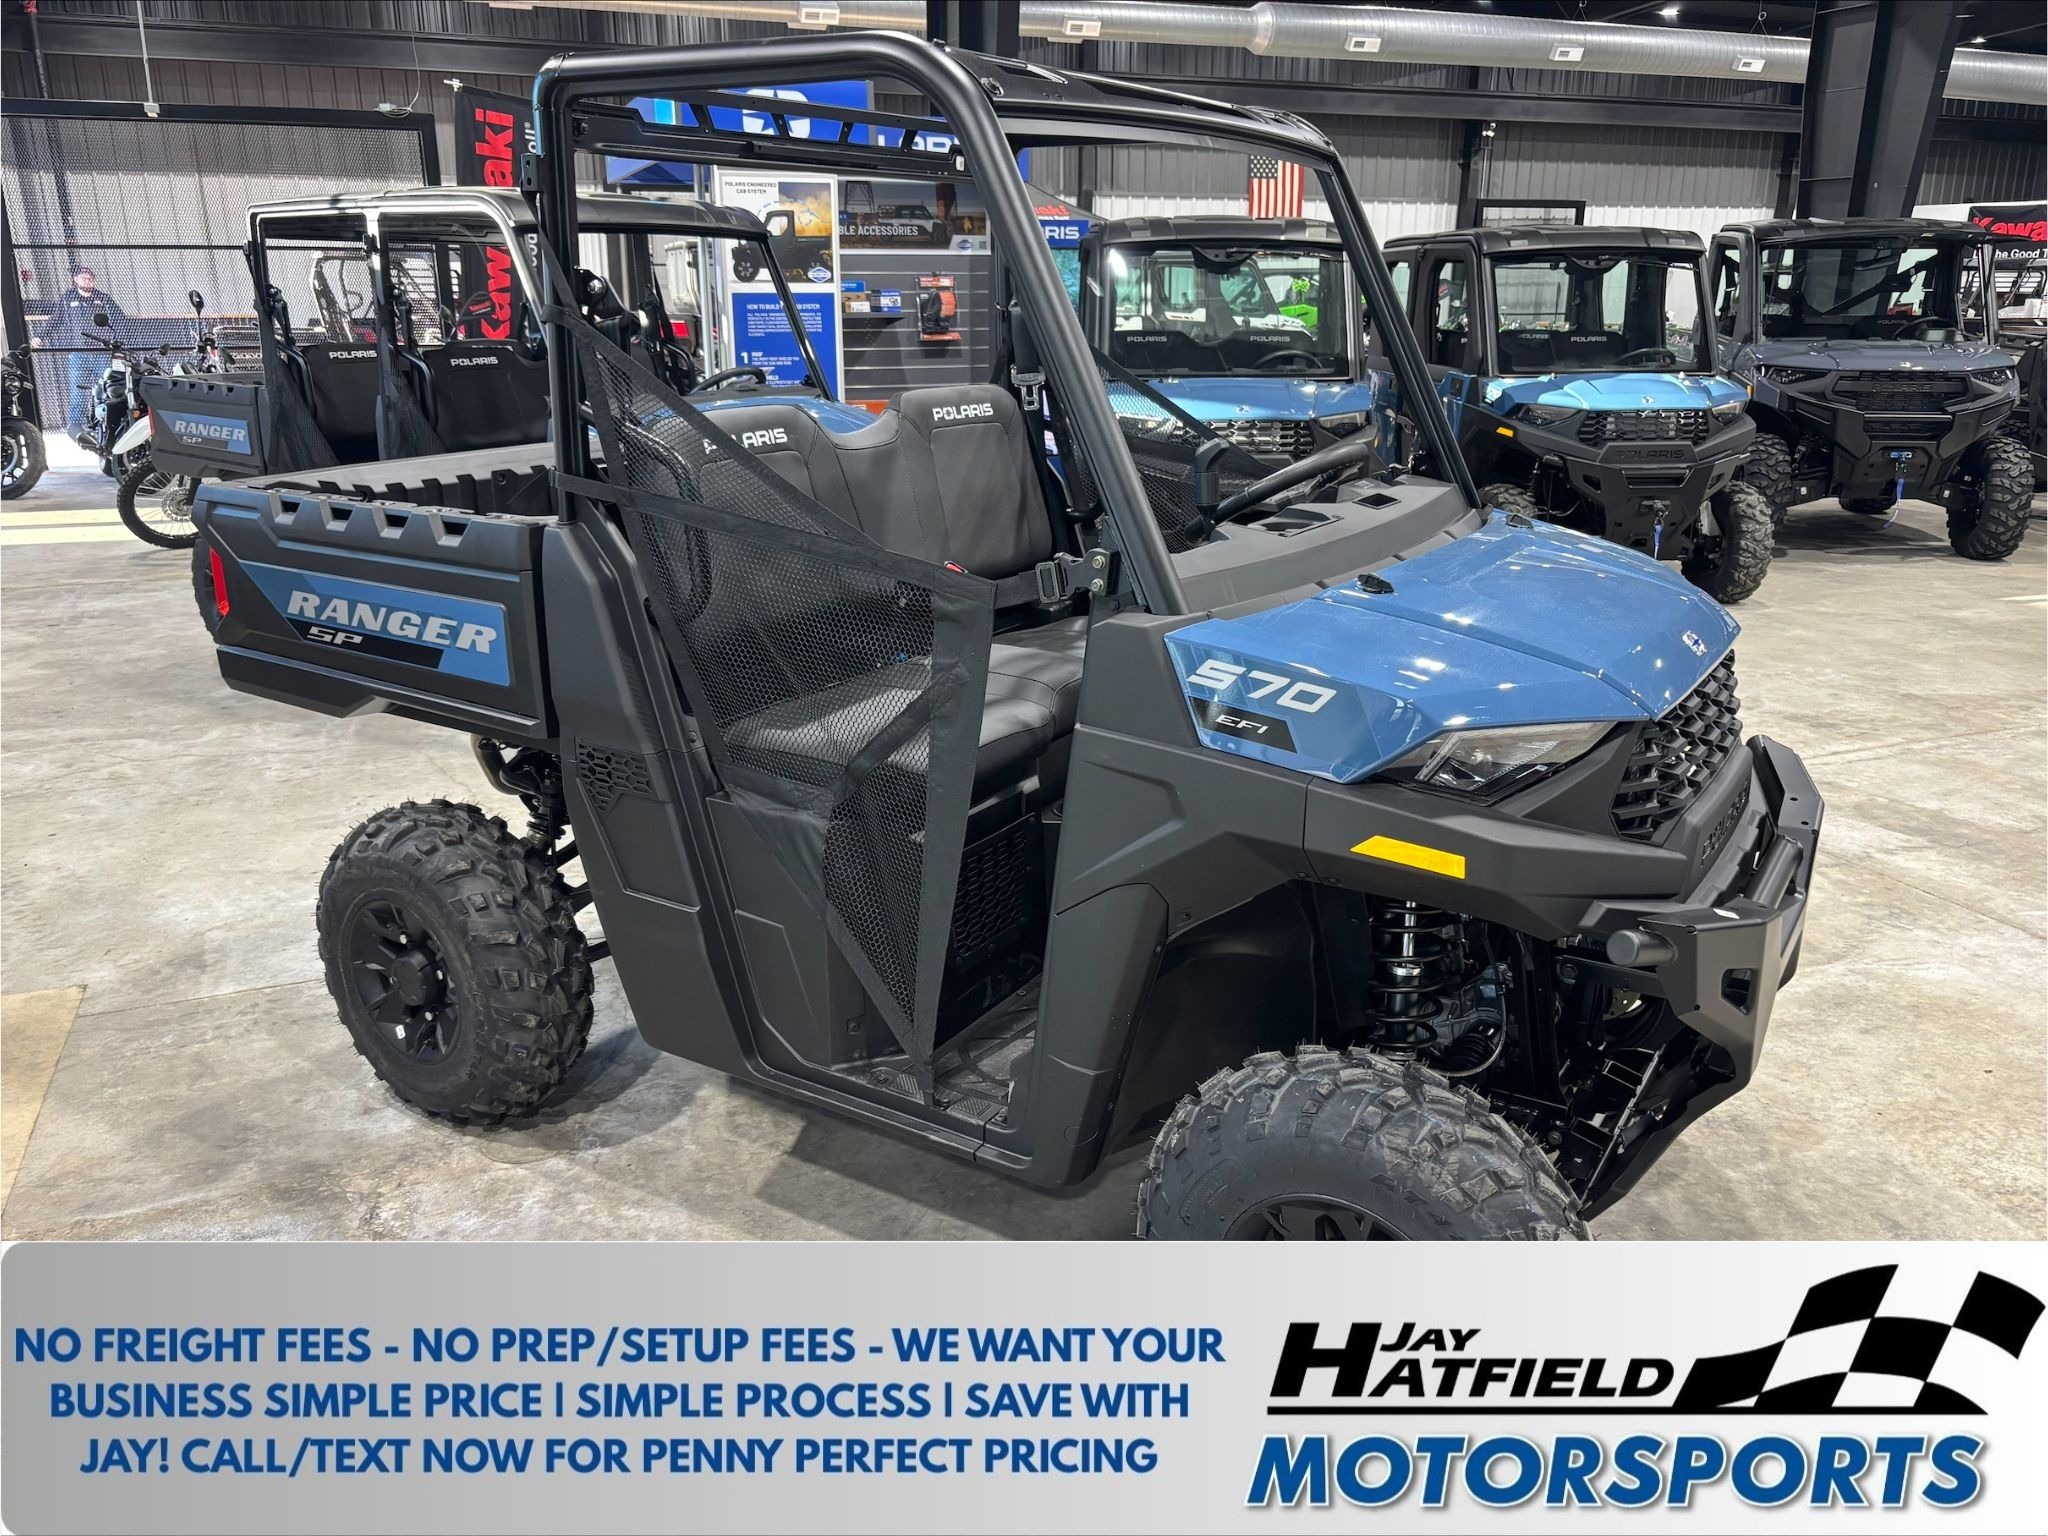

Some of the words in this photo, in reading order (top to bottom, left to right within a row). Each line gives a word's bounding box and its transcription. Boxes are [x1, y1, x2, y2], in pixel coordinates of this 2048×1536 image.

[475, 108, 513, 340] Kawaki
[857, 225, 919, 236] ACCESSORIES
[2010, 248, 2041, 259] Good
[1127, 335, 1167, 343] POLARIS
[1250, 334, 1291, 343] POLARIS
[329, 350, 377, 359] POLARIS
[741, 352, 748, 364] 1
[450, 356, 499, 366] POLARIS
[932, 402, 993, 421] POLARIS
[174, 420, 246, 442] RANGER
[182, 435, 202, 443] SP
[286, 590, 498, 654] RANGER
[307, 626, 363, 645] SP
[1187, 658, 1338, 713] 570
[1216, 714, 1269, 734] EFI
